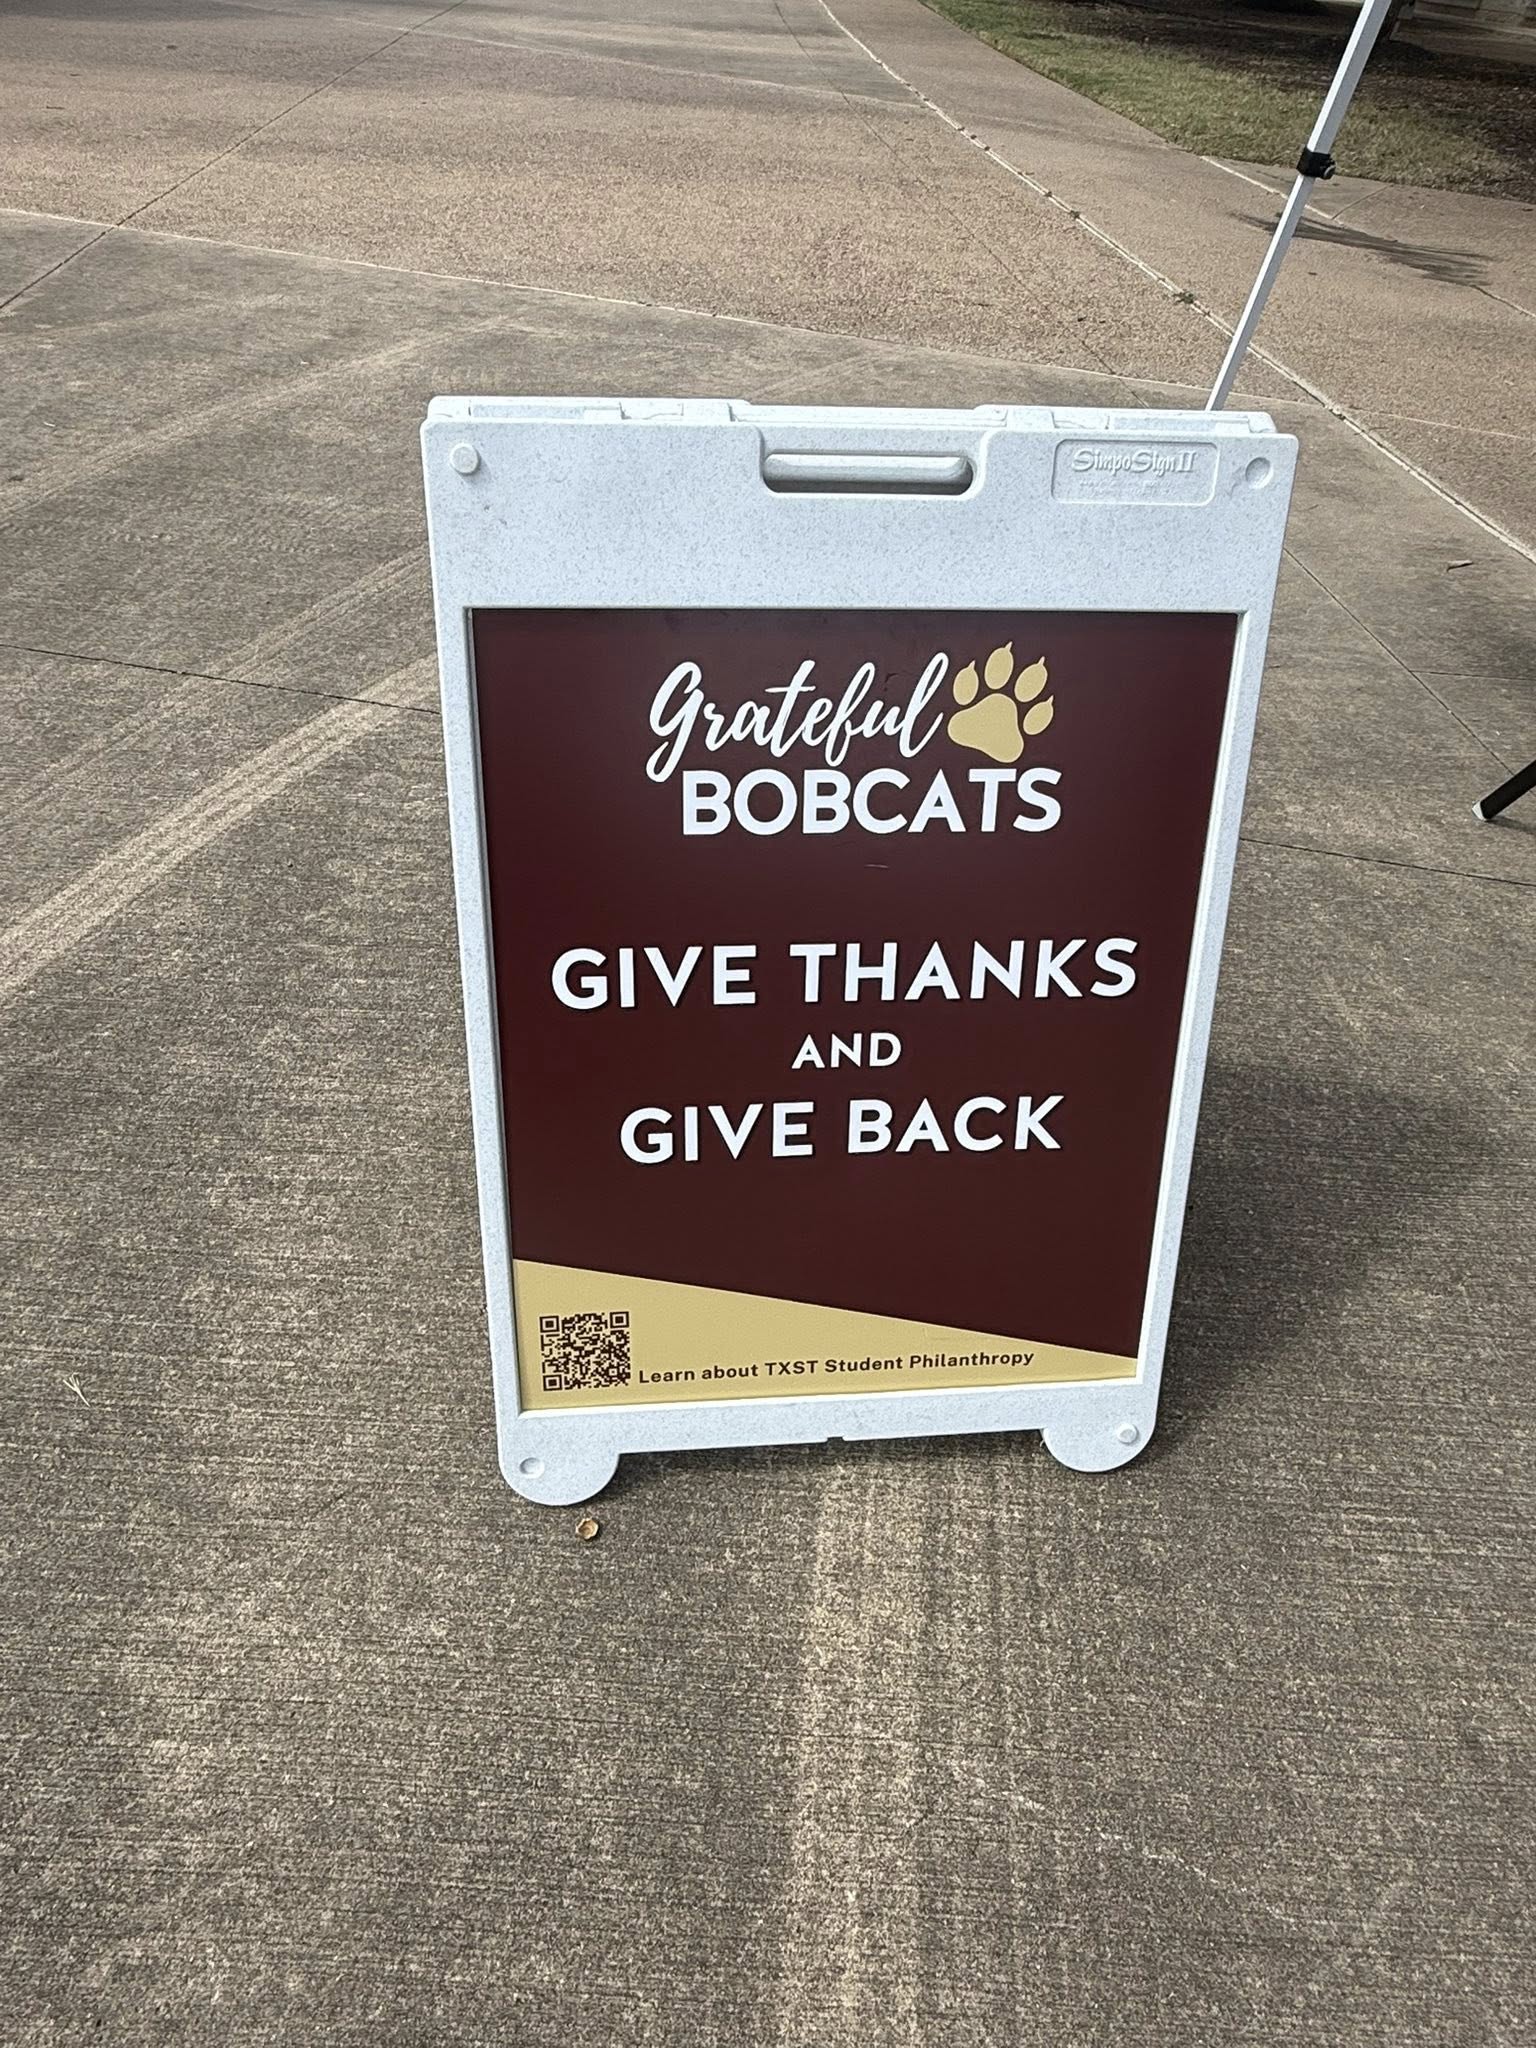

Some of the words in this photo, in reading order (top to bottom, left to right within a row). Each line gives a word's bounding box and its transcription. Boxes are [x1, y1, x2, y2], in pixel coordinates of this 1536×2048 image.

[645, 652, 950, 783] Grateful
[682, 767, 1063, 836] BOBCATS
[551, 944, 758, 1010] GIVE
[789, 937, 1138, 1003] THANKS
[791, 1032, 902, 1069] AND
[620, 1101, 814, 1164] GIVE
[847, 1095, 1063, 1154] BACK
[638, 1369, 695, 1384] Learn
[701, 1364, 758, 1380] about
[764, 1360, 818, 1376] TXST
[824, 1356, 903, 1373] Student
[908, 1351, 1034, 1369] Philanthropy
